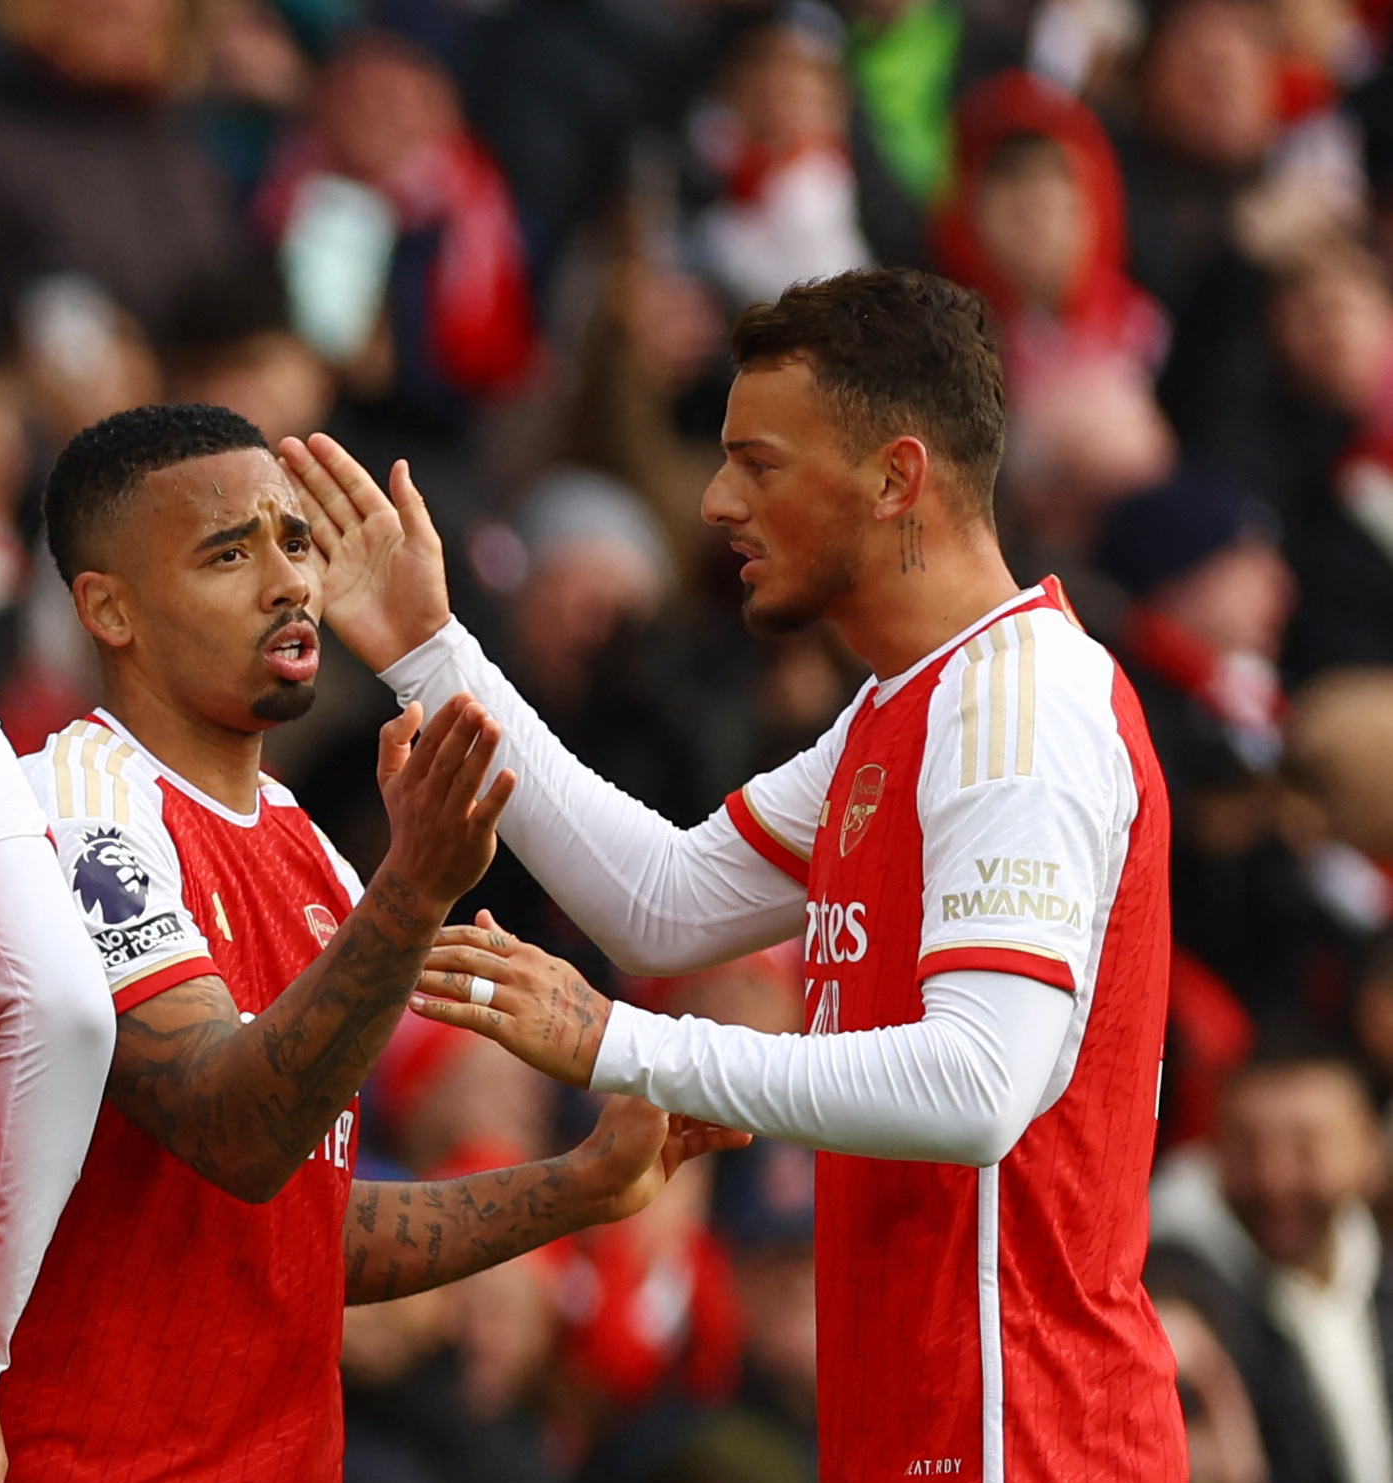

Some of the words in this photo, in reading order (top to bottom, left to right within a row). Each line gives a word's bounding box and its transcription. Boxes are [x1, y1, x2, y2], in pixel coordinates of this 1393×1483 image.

[974, 857, 1061, 889] VISIT
[942, 889, 1082, 932] RWANDA
[903, 1457, 963, 1476] EAT.RDY
